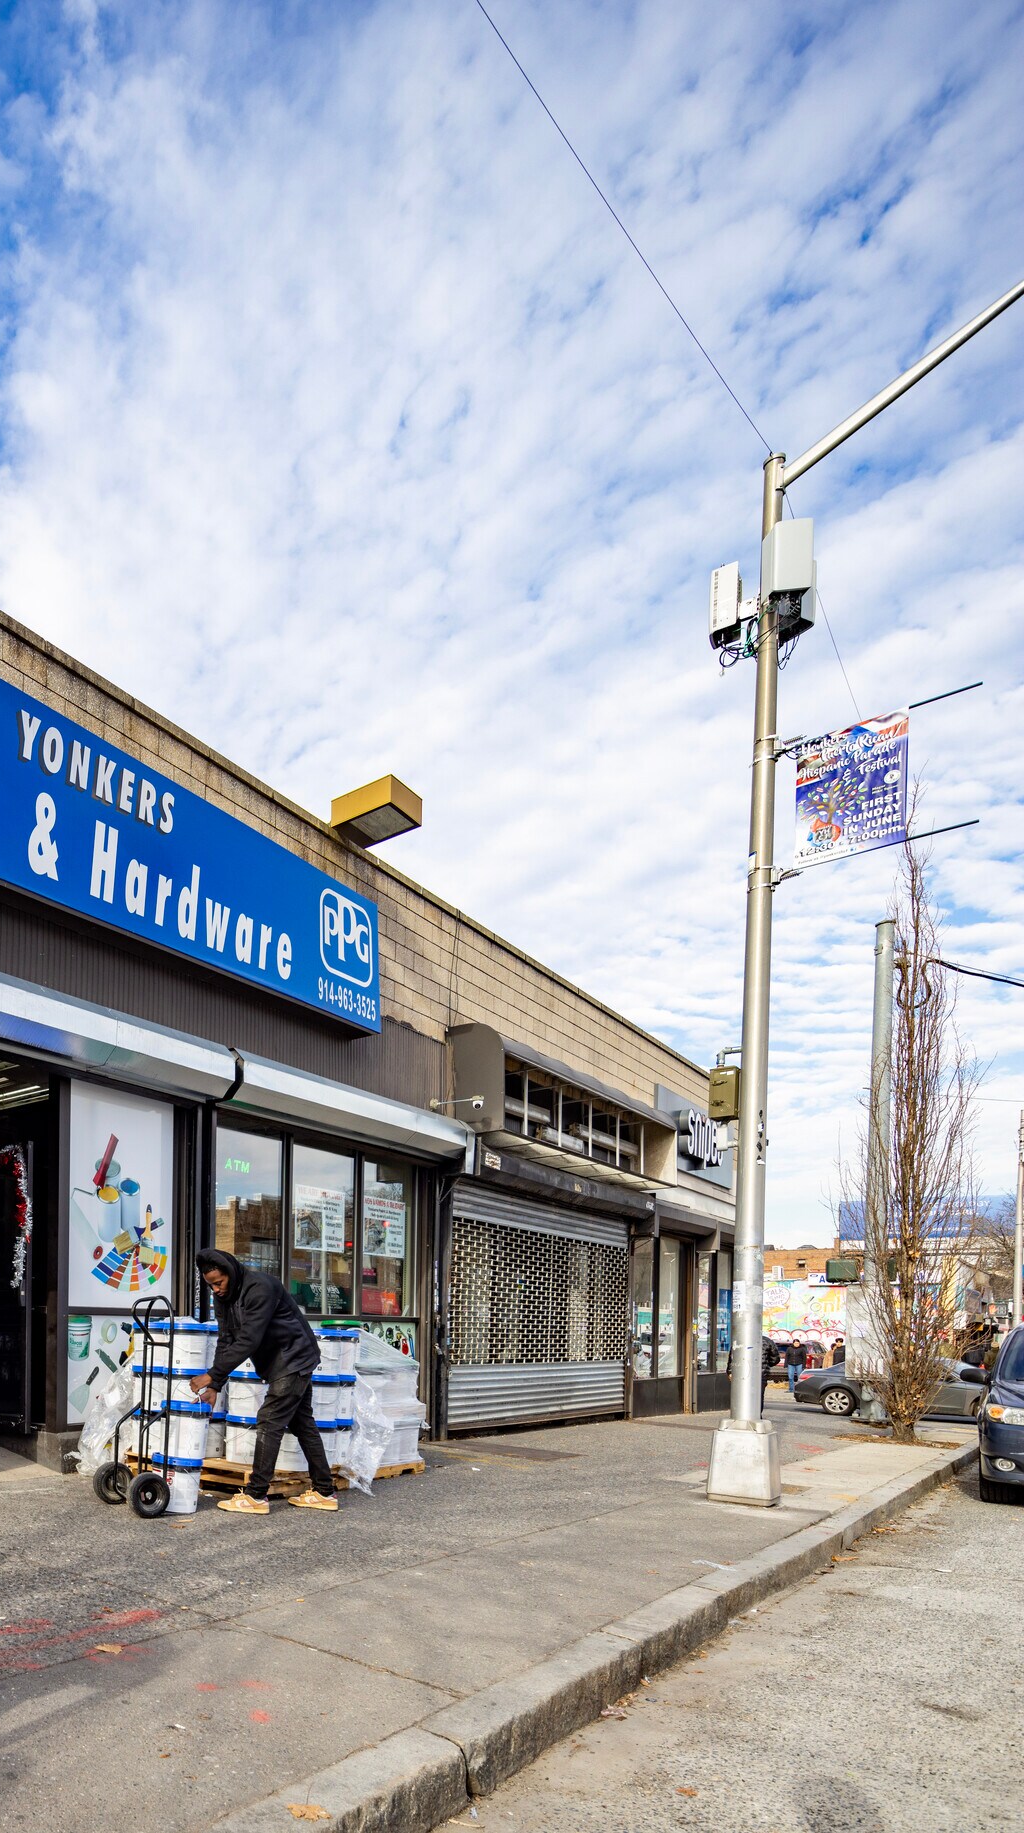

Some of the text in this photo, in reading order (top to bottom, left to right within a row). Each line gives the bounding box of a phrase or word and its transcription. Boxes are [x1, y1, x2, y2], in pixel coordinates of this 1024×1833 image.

[17, 708, 176, 834] YONKERS
[798, 741, 897, 781] Hispanic Parade
[855, 751, 903, 774] Festival
[843, 801, 902, 825] SUNDAY
[861, 791, 903, 810] FIRST
[843, 825, 858, 836] IN
[862, 813, 902, 830] JUNE
[27, 792, 60, 882] &
[89, 820, 293, 980] Hardware
[323, 895, 369, 964] PPG
[318, 976, 376, 1021] 914-963-3525
[224, 1157, 251, 1174] ATM
